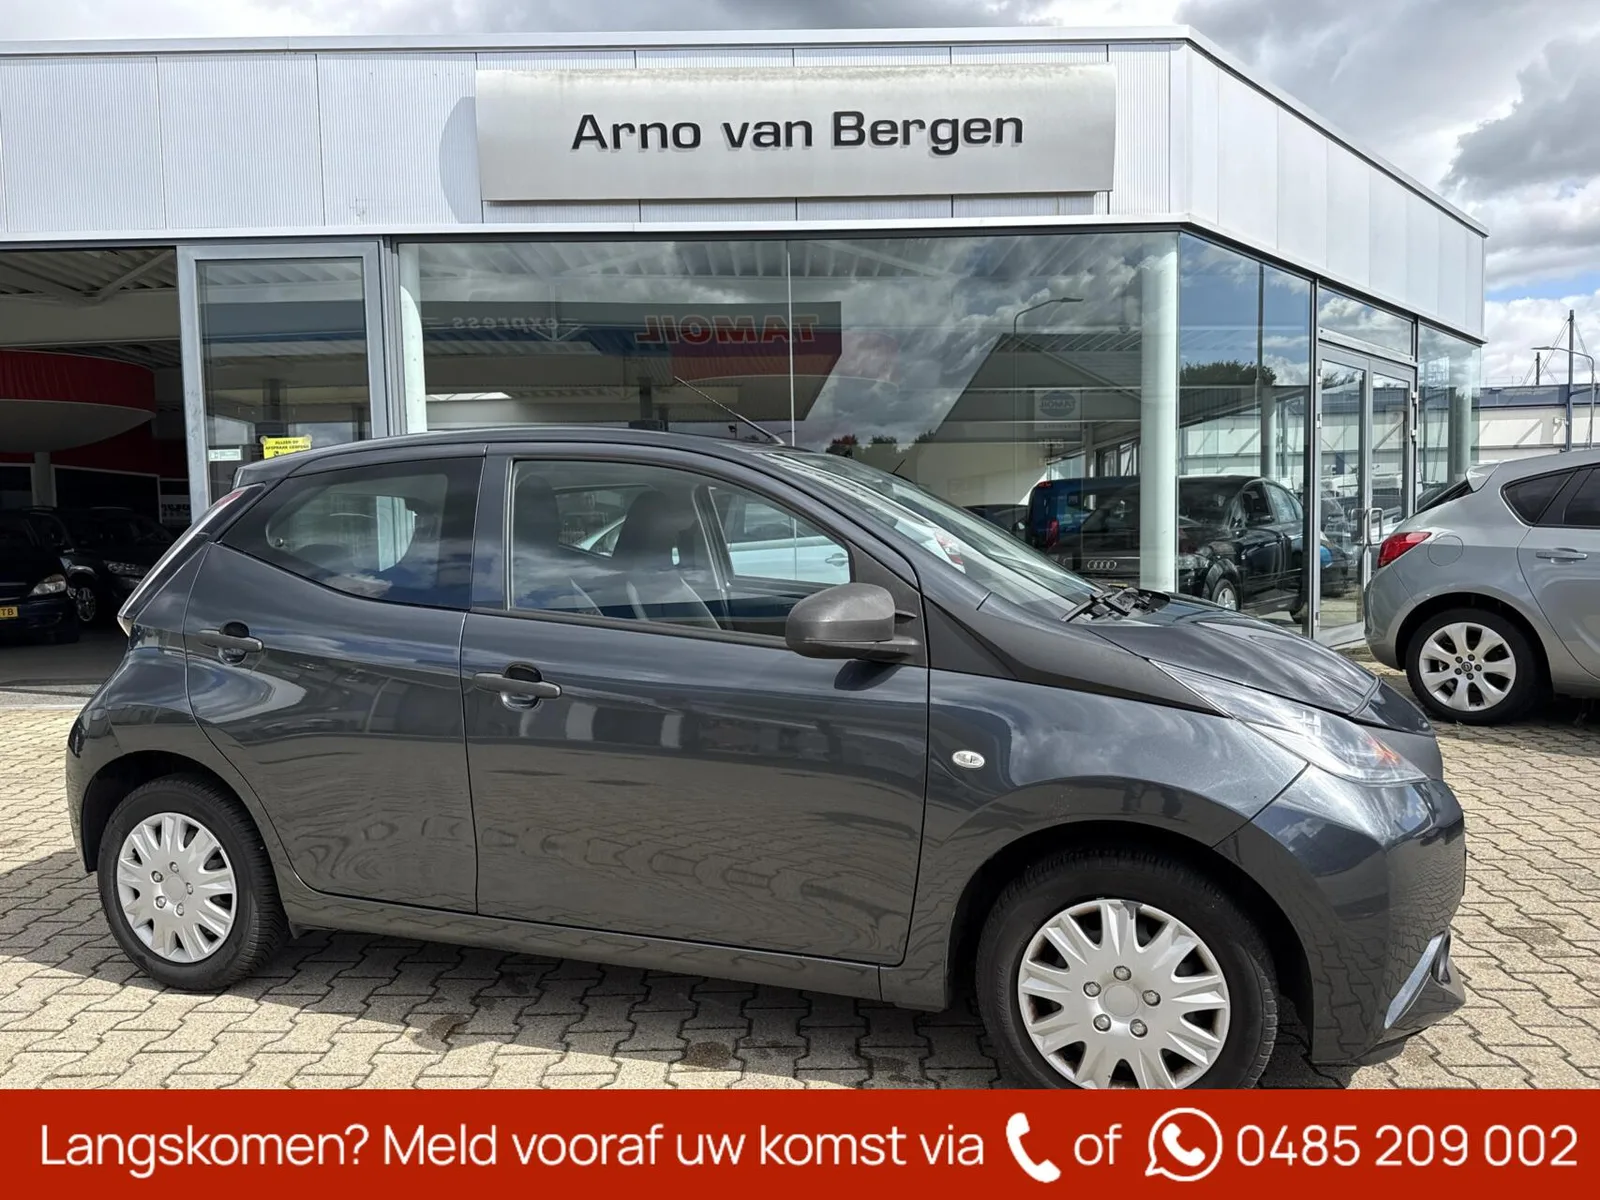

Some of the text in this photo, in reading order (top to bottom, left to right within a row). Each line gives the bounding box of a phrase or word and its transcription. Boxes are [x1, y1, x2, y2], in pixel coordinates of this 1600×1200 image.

[572, 111, 1024, 156] Arno van Bergen
